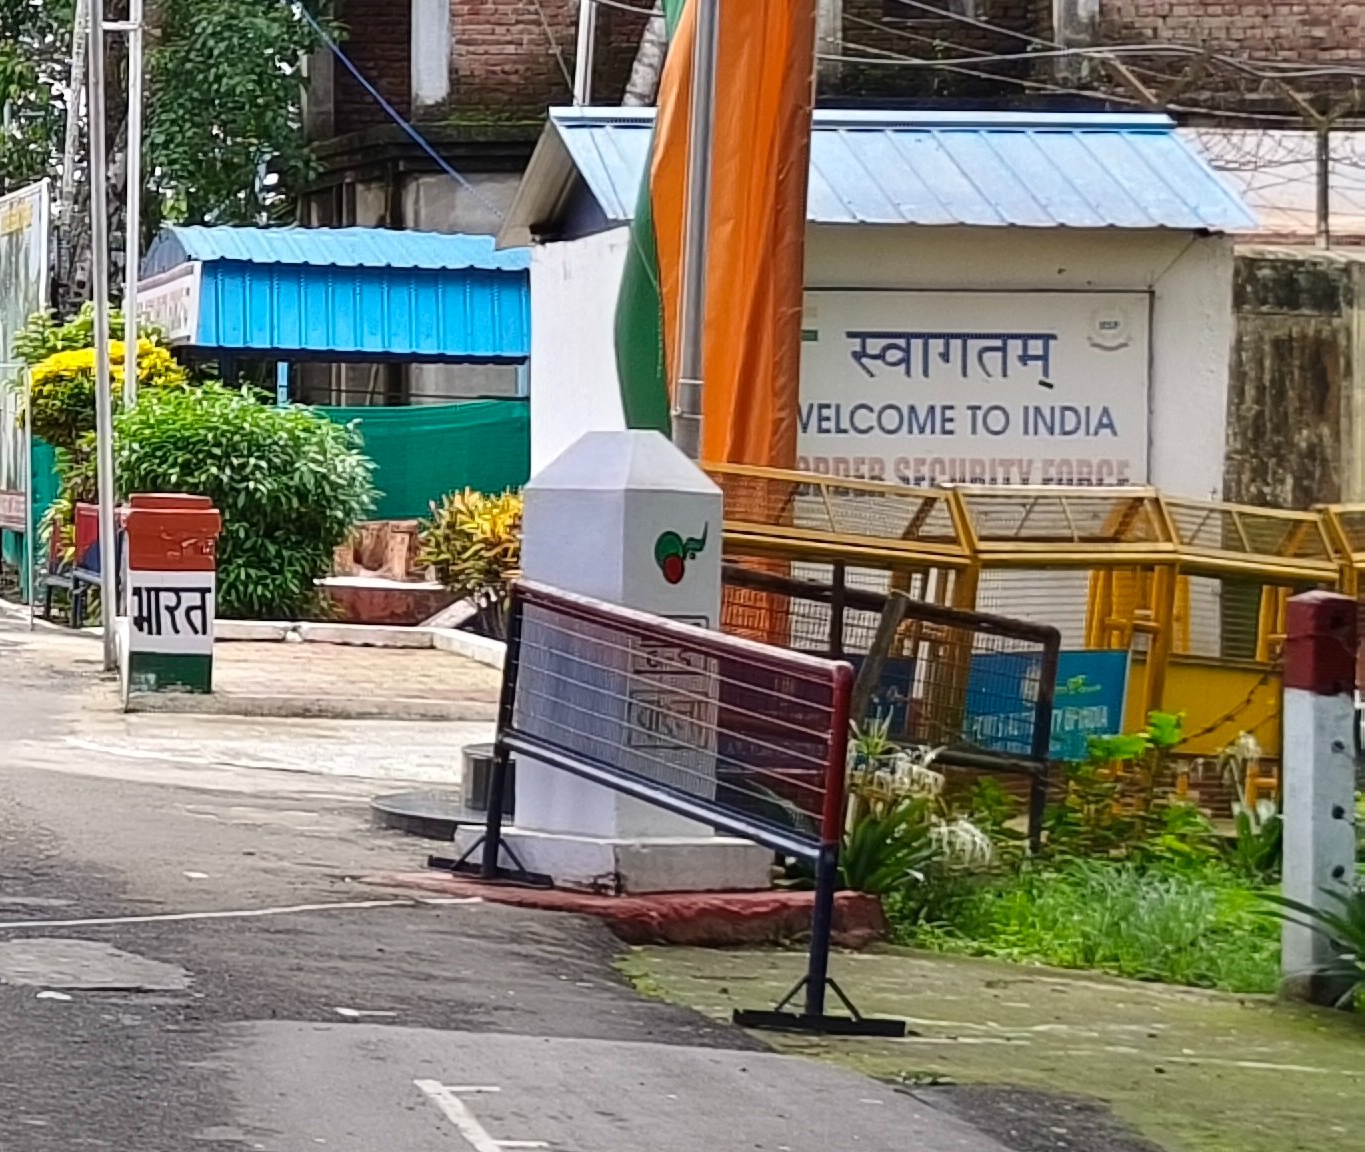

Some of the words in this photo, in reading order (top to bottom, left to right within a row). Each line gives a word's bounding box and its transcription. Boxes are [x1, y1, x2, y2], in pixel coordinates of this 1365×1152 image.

[967, 405, 1010, 435] TO
[1022, 405, 1118, 436] INDIA
[132, 586, 212, 636] भारत
